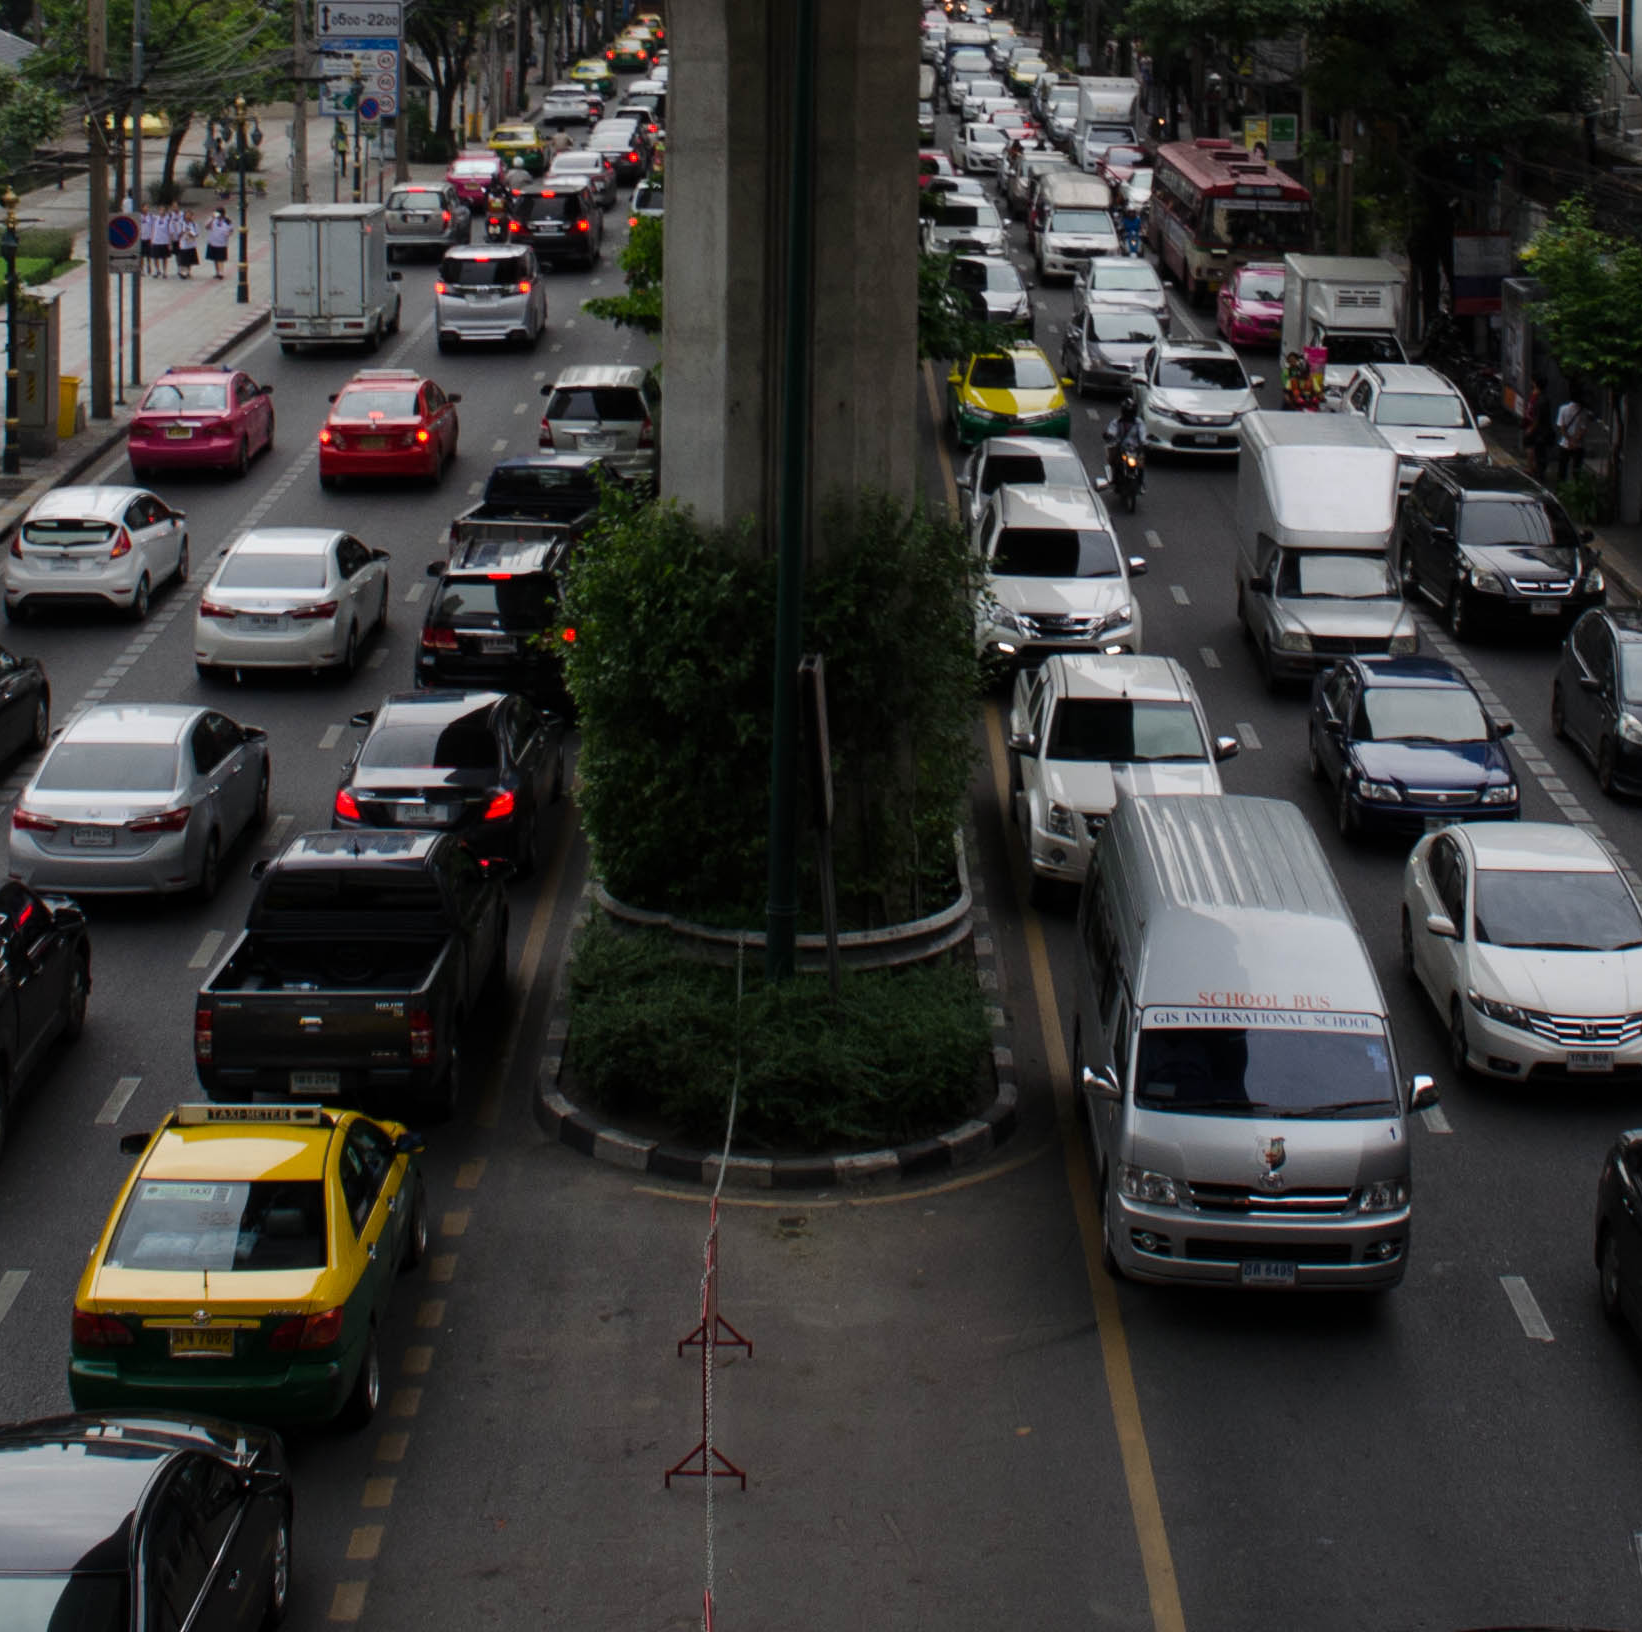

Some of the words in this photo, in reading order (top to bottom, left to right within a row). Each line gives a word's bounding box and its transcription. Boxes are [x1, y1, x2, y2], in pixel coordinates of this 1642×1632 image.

[1197, 991, 1286, 1009] SCHOOL
[1293, 994, 1332, 1010] BUS
[1153, 1012, 1179, 1025] GIS
[1185, 1012, 1306, 1026] INTERNATIONAL
[1313, 1016, 1374, 1029] SCHOOL
[208, 1109, 291, 1120] TAXI-METER
[1388, 1126, 1397, 1140] 1
